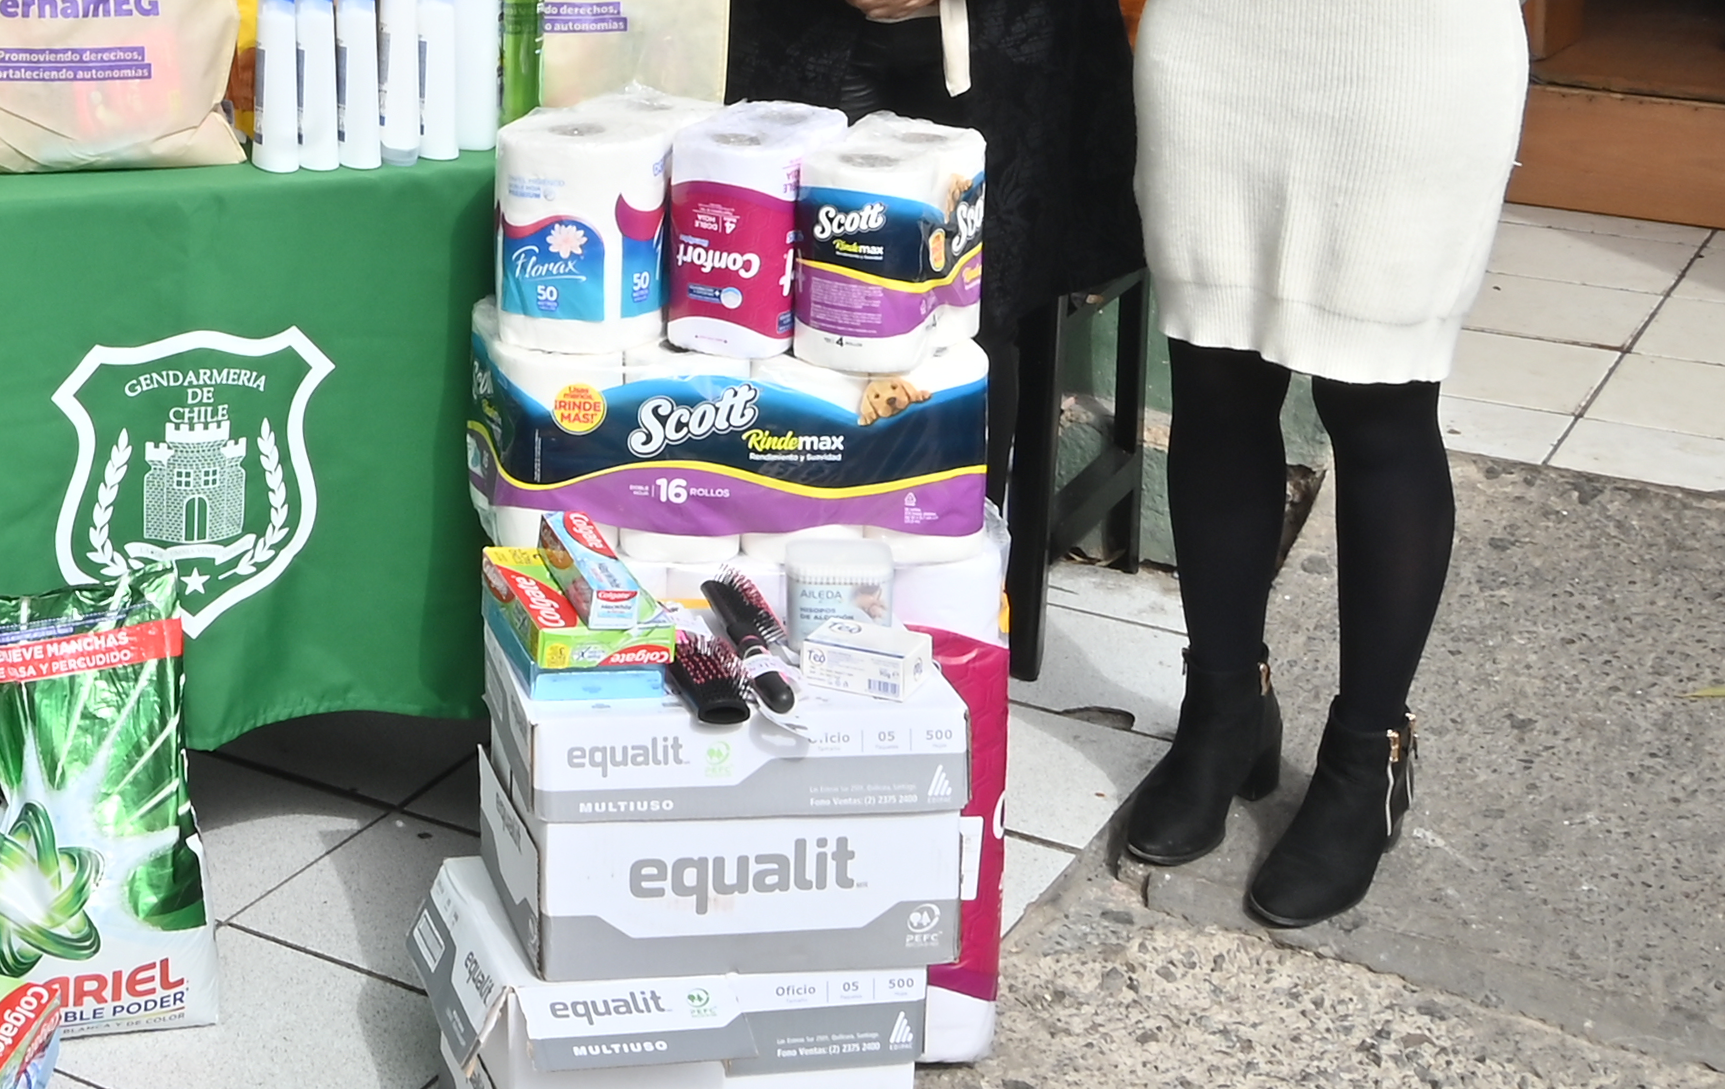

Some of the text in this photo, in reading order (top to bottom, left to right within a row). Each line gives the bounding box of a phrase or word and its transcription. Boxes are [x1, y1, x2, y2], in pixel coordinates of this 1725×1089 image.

[560, 3, 619, 15] derechos,
[82, 48, 143, 63] derechos,
[76, 65, 149, 79] autonomías
[813, 203, 887, 241] Scott
[511, 245, 579, 279] Florax
[677, 243, 761, 279] Confort
[632, 271, 650, 292] 50
[536, 285, 558, 302] 50
[835, 336, 844, 347] 4
[123, 367, 266, 398] GENDARMERIA
[186, 387, 215, 404] DE
[168, 404, 230, 423] CHILE
[554, 400, 601, 413] ¡RINDE
[628, 383, 761, 458] Scott
[741, 428, 845, 453] Rindemax
[748, 452, 799, 462] Rendimiento
[806, 452, 842, 462] Suavidad
[655, 477, 730, 504] 16 ROLLOS
[569, 512, 604, 550] Colgate
[514, 575, 566, 628] Colgate
[597, 591, 631, 601] Colgate
[799, 589, 843, 600] AILEDA
[46, 631, 130, 658] MANCHAS
[39, 662, 50, 675] Y
[52, 649, 132, 672] PERCUDIDO
[610, 649, 669, 665] Colgate
[806, 649, 826, 663] Teo
[808, 731, 851, 744] icio
[877, 730, 896, 742] 05
[925, 729, 953, 741] 500
[566, 736, 683, 778] equalit
[579, 799, 674, 813] MULTIUSO
[809, 797, 831, 807] Fono
[832, 796, 862, 806] Ventas:
[864, 795, 876, 807] (2)
[628, 836, 855, 915] equalit
[905, 933, 939, 944] PEFC
[42, 957, 185, 1009] ARIEL
[463, 951, 495, 1008] equalit
[842, 981, 859, 992] 05
[888, 977, 915, 989] 500
[775, 984, 817, 997] Oficio
[63, 990, 186, 1023] BLE PODER
[549, 990, 666, 1026] equalit
[63, 1022, 111, 1034] BLANCA
[126, 1019, 142, 1027] DE
[145, 1012, 186, 1024] COLOR
[572, 1040, 668, 1057] MULTIUSO
[776, 1048, 798, 1058] Fono
[798, 1046, 828, 1057] Ventas:
[828, 1044, 841, 1055] (2)
